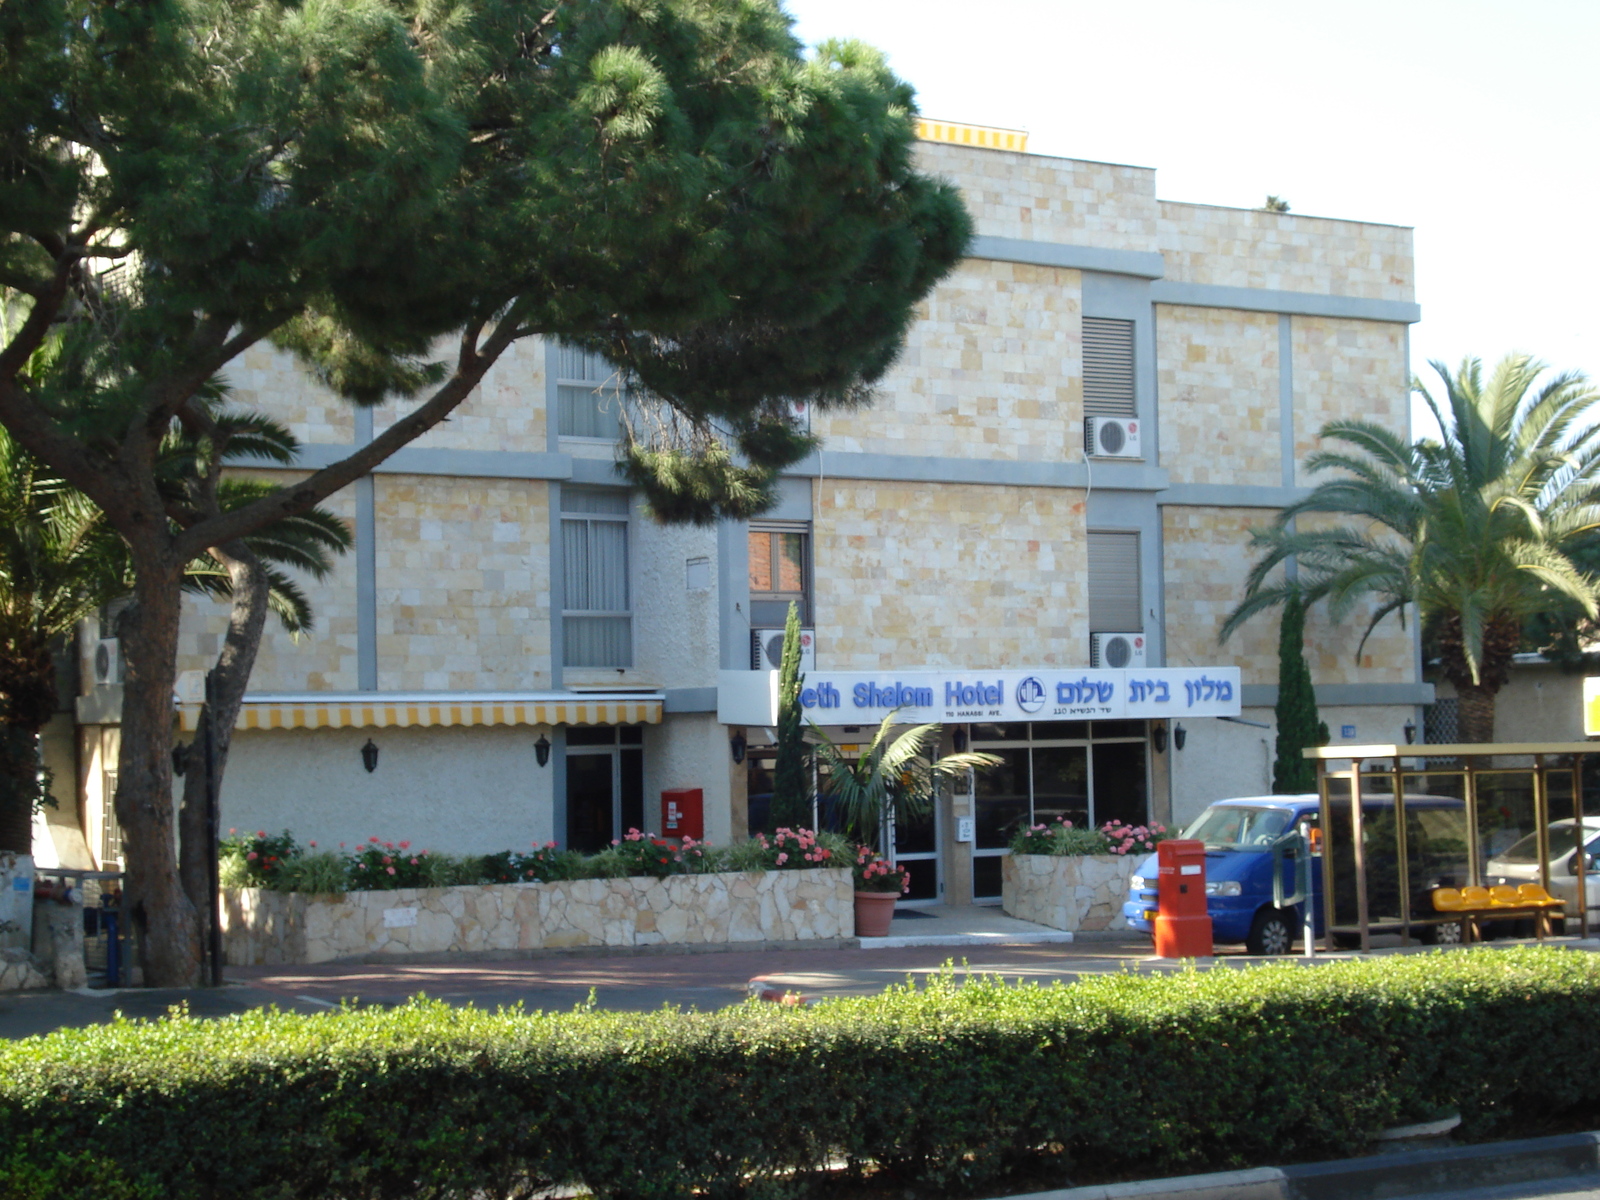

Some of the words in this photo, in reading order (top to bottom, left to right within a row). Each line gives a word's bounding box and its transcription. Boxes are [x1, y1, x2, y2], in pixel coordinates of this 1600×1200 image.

[798, 681, 841, 708] eth
[853, 681, 933, 708] Shalom
[945, 679, 1004, 707] Hotel
[1056, 676, 1114, 704] שלום
[1128, 679, 1171, 703] בית
[1184, 675, 1233, 708] מלון
